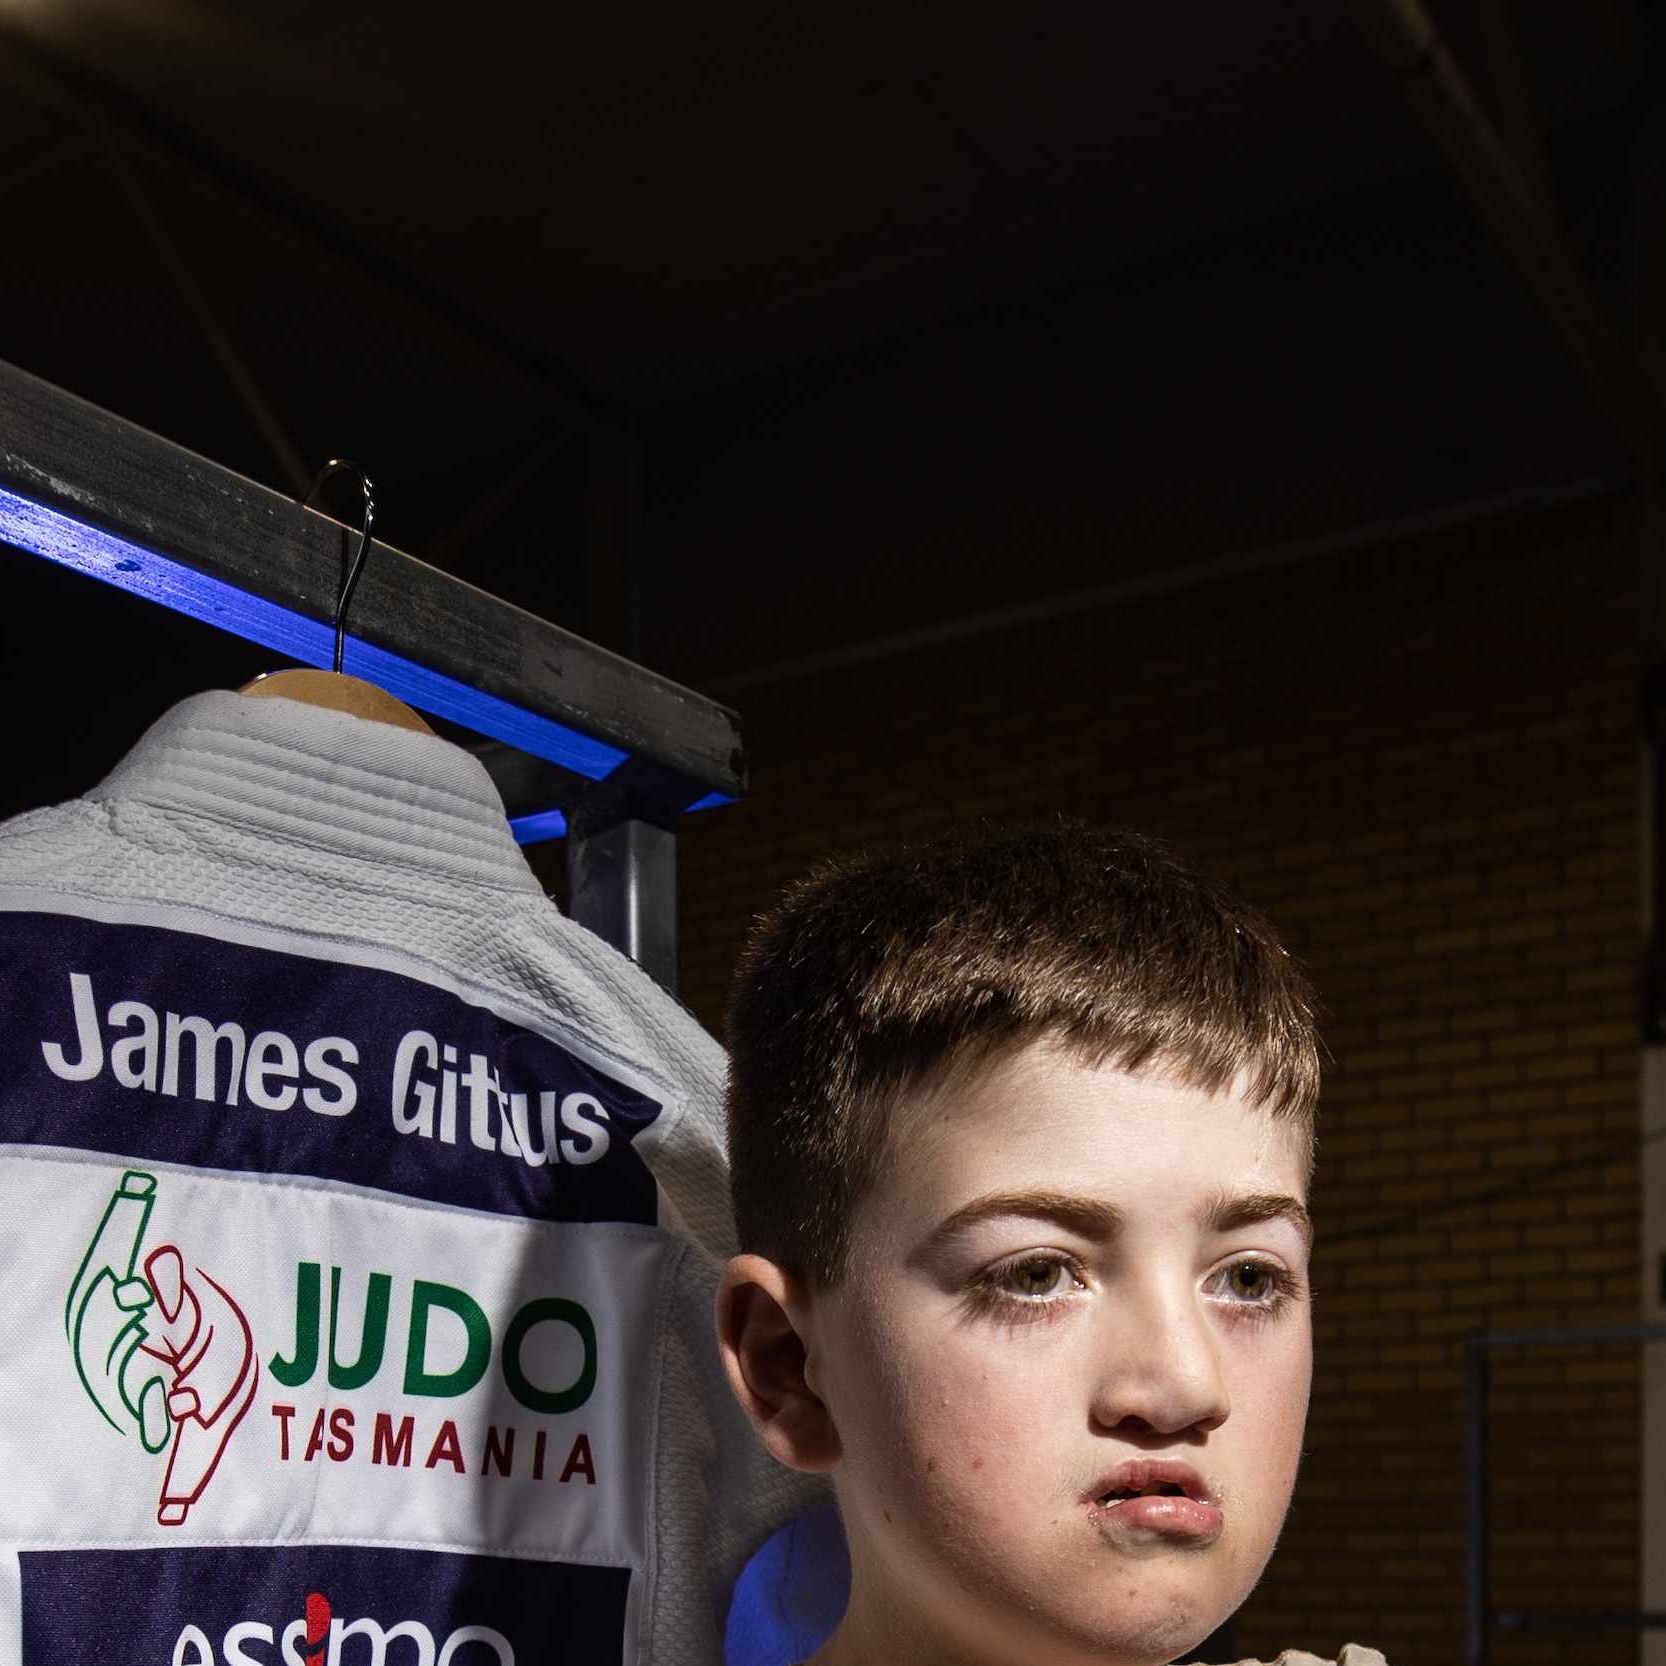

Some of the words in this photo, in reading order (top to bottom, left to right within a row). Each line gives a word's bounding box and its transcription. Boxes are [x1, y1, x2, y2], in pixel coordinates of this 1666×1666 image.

[40, 972, 360, 1117] James
[268, 1262, 598, 1415] JUDO
[270, 1404, 598, 1486] TASMANIA
